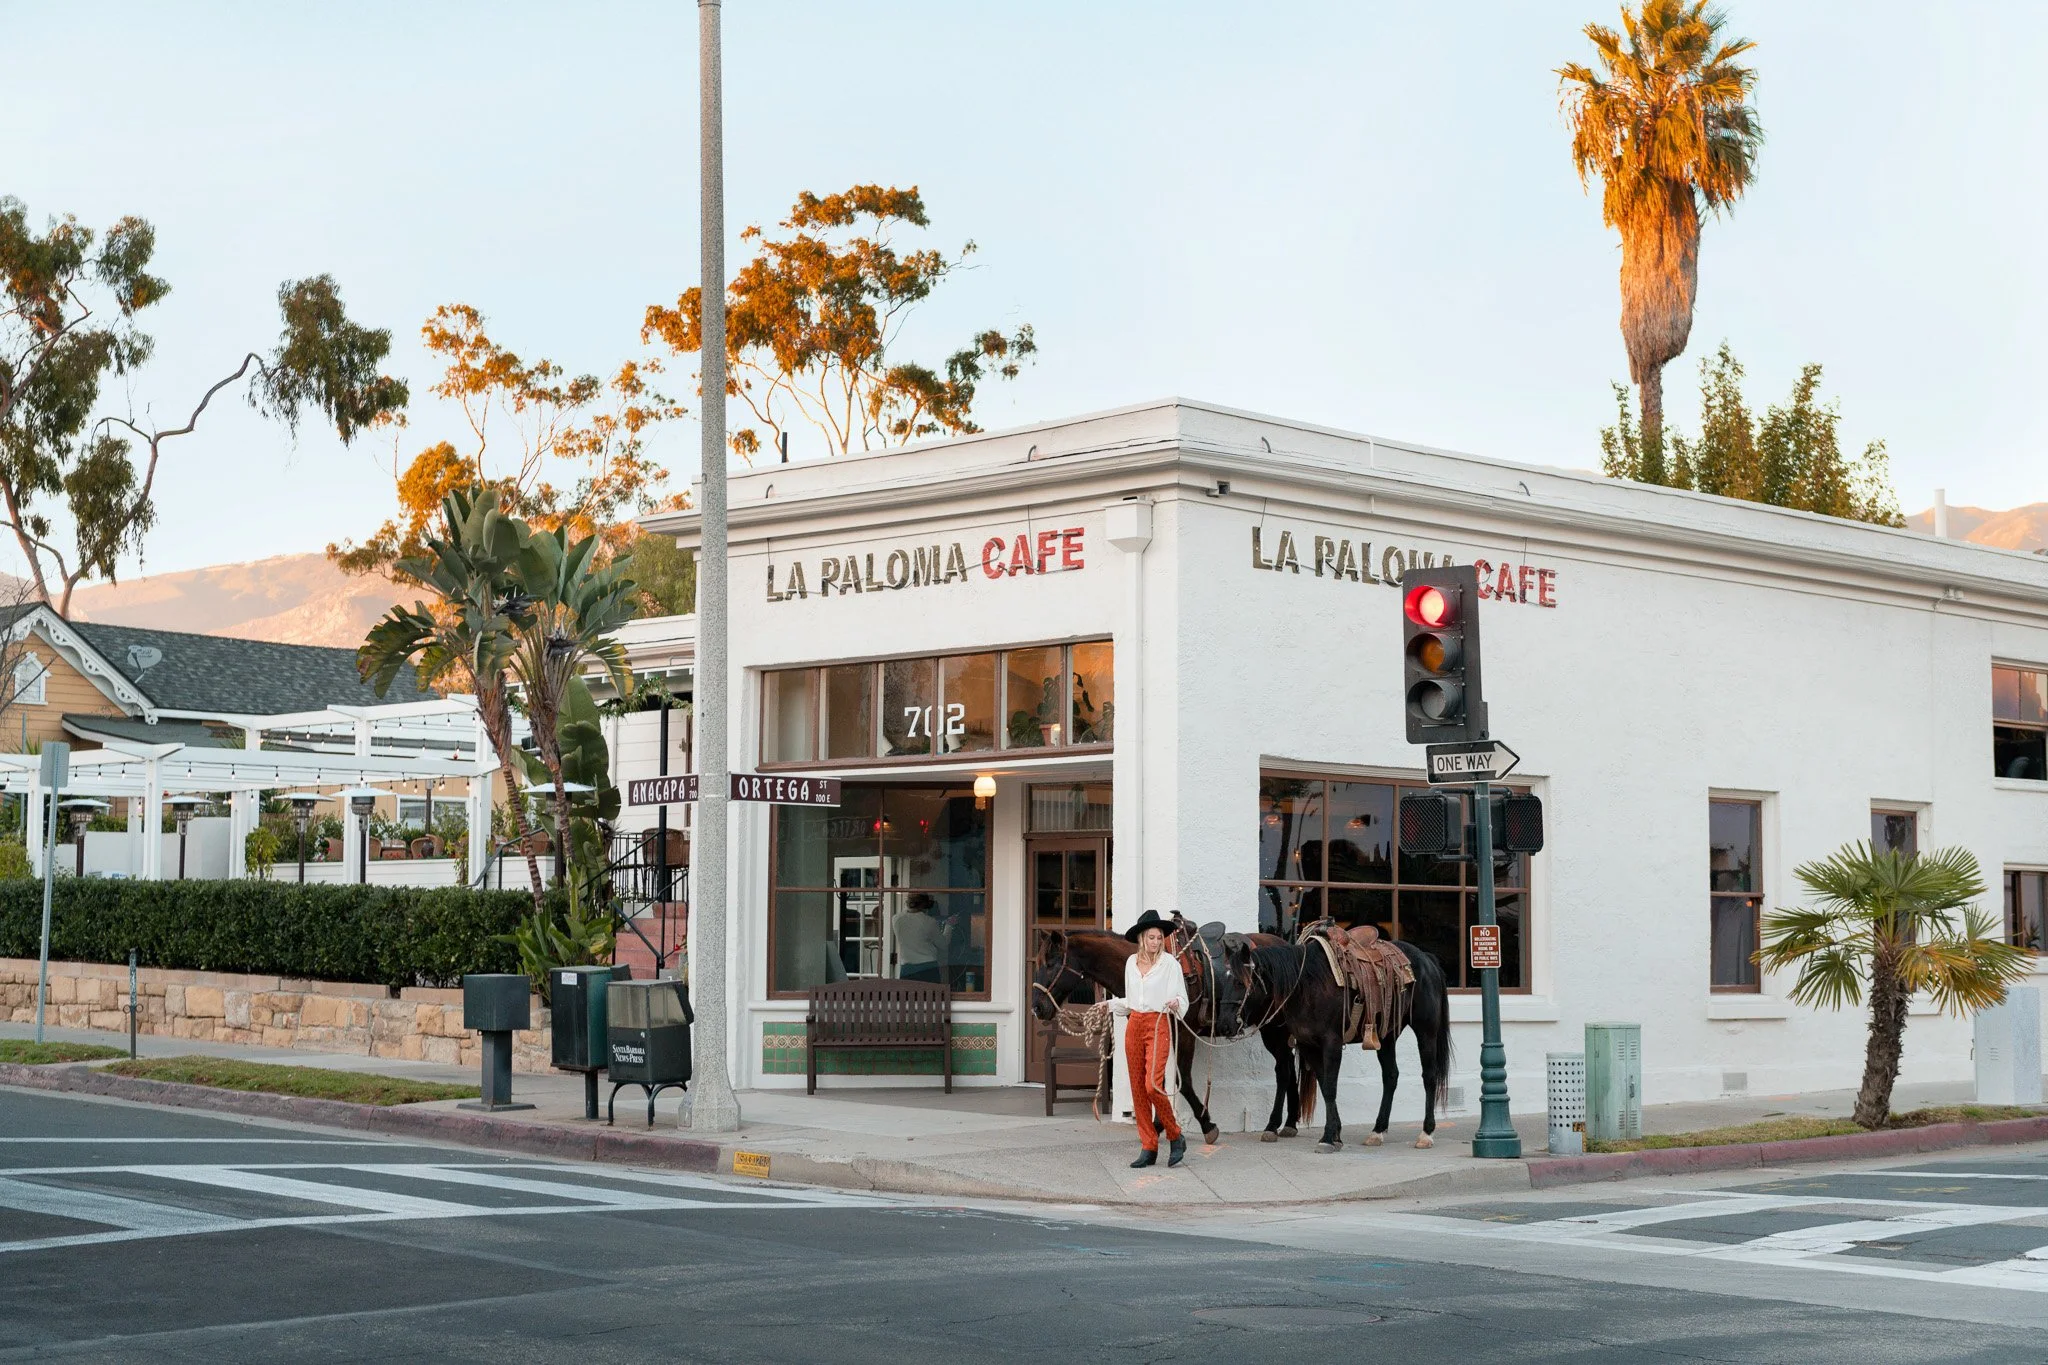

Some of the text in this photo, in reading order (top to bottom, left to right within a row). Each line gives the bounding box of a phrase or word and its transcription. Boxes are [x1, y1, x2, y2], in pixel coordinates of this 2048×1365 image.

[766, 527, 1085, 603] LA PALOMA CAFE
[1252, 526, 1300, 574] LA
[1474, 559, 1556, 608] CAFE
[904, 703, 965, 738] 702
[1437, 754, 1492, 772] ONE WAY
[632, 778, 697, 804] ANACAPA ST
[689, 790, 698, 799] 700
[738, 777, 828, 801] ORTEGA ST
[826, 794, 831, 803] E
